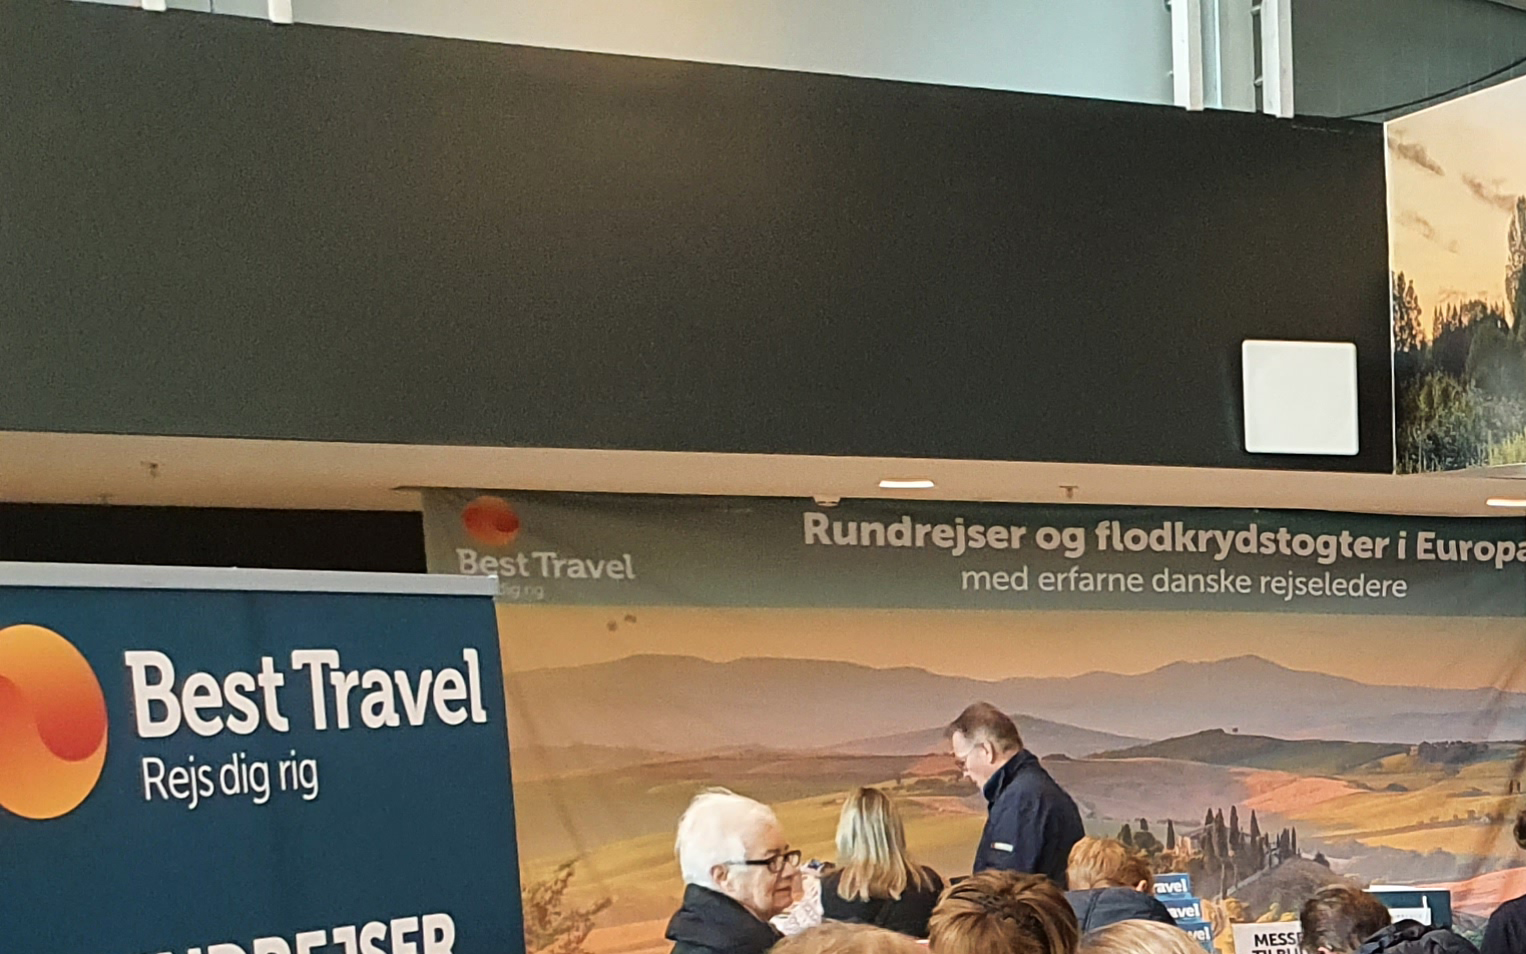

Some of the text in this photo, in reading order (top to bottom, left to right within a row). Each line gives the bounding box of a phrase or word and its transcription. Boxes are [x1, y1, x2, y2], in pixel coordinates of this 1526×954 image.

[456, 548, 636, 579] Best Travel
[803, 512, 1026, 557] Rundrejser
[1036, 524, 1085, 558] og
[1097, 520, 1389, 565] flodkrydstogter
[1397, 531, 1407, 560] i
[961, 565, 1408, 601] med erfarne danske rejseledere
[124, 647, 487, 738] Best Travel
[142, 750, 318, 810] Rejs dig rig
